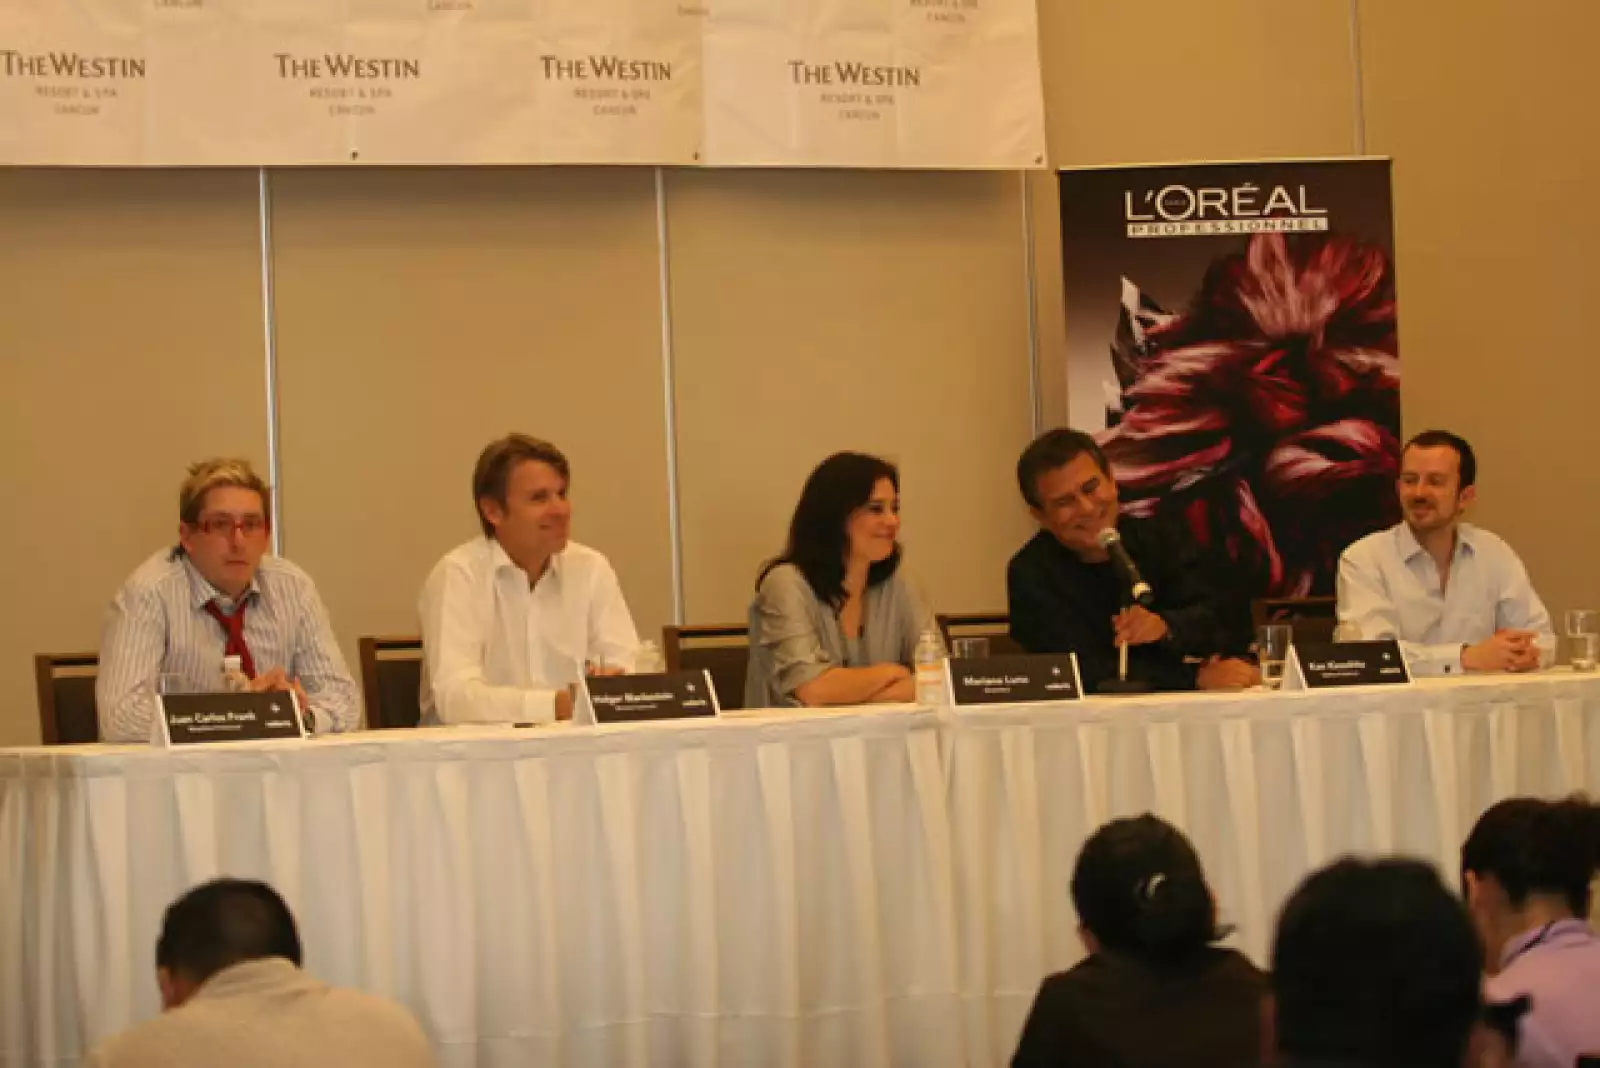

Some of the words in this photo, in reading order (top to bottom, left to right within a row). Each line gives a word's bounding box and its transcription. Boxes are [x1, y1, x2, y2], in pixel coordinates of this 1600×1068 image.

[1, 50, 46, 77] THE
[48, 51, 146, 77] WESTIN
[274, 53, 321, 78] THE
[323, 53, 420, 78] WESTIN
[540, 55, 588, 80] THE
[588, 55, 671, 80] WESTIN
[788, 59, 833, 84] THE
[834, 61, 920, 86] WESTIN
[1125, 183, 1328, 220] L'ORÉAL
